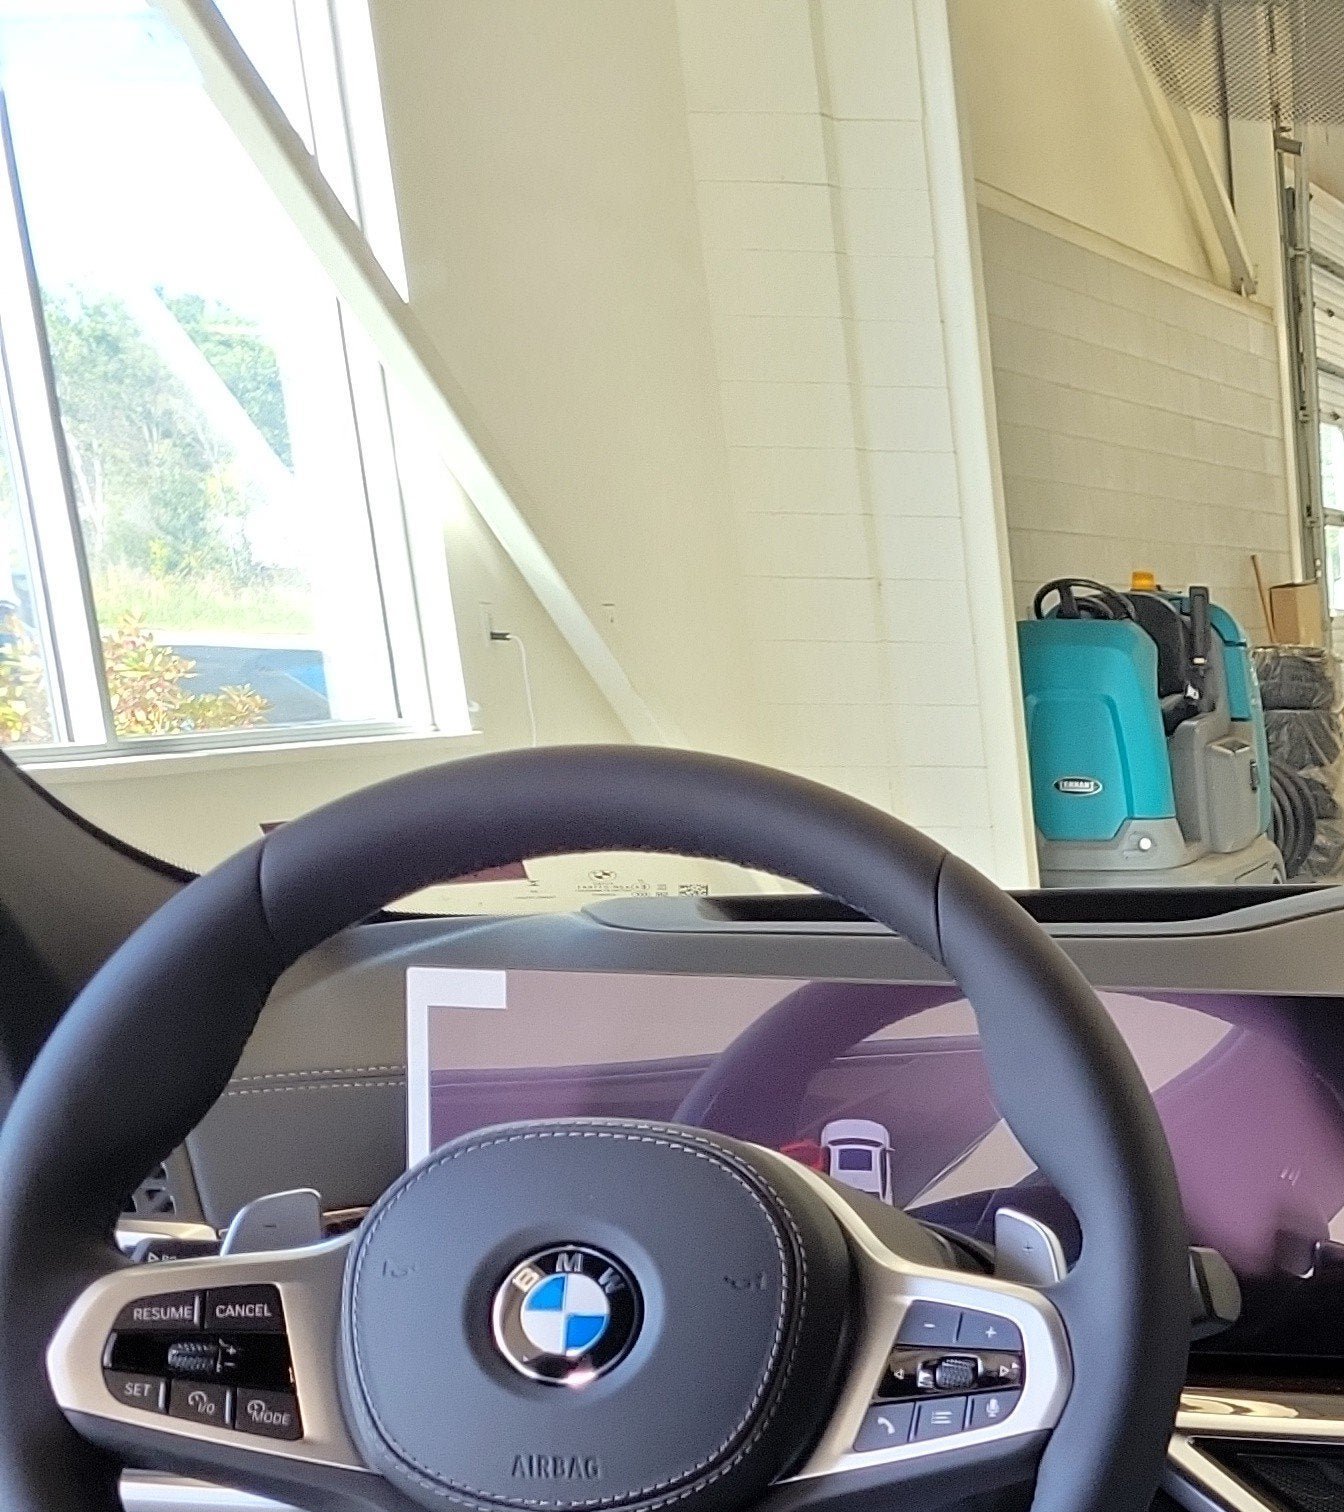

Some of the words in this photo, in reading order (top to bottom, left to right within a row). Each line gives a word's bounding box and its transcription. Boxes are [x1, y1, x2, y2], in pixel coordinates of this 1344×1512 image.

[511, 1252, 626, 1294] BMW
[133, 1306, 193, 1320] RESUME
[215, 1303, 272, 1318] CANCEL
[124, 1382, 151, 1397] SET
[251, 1410, 292, 1425] MODE
[511, 1454, 600, 1479] AIRBAG
